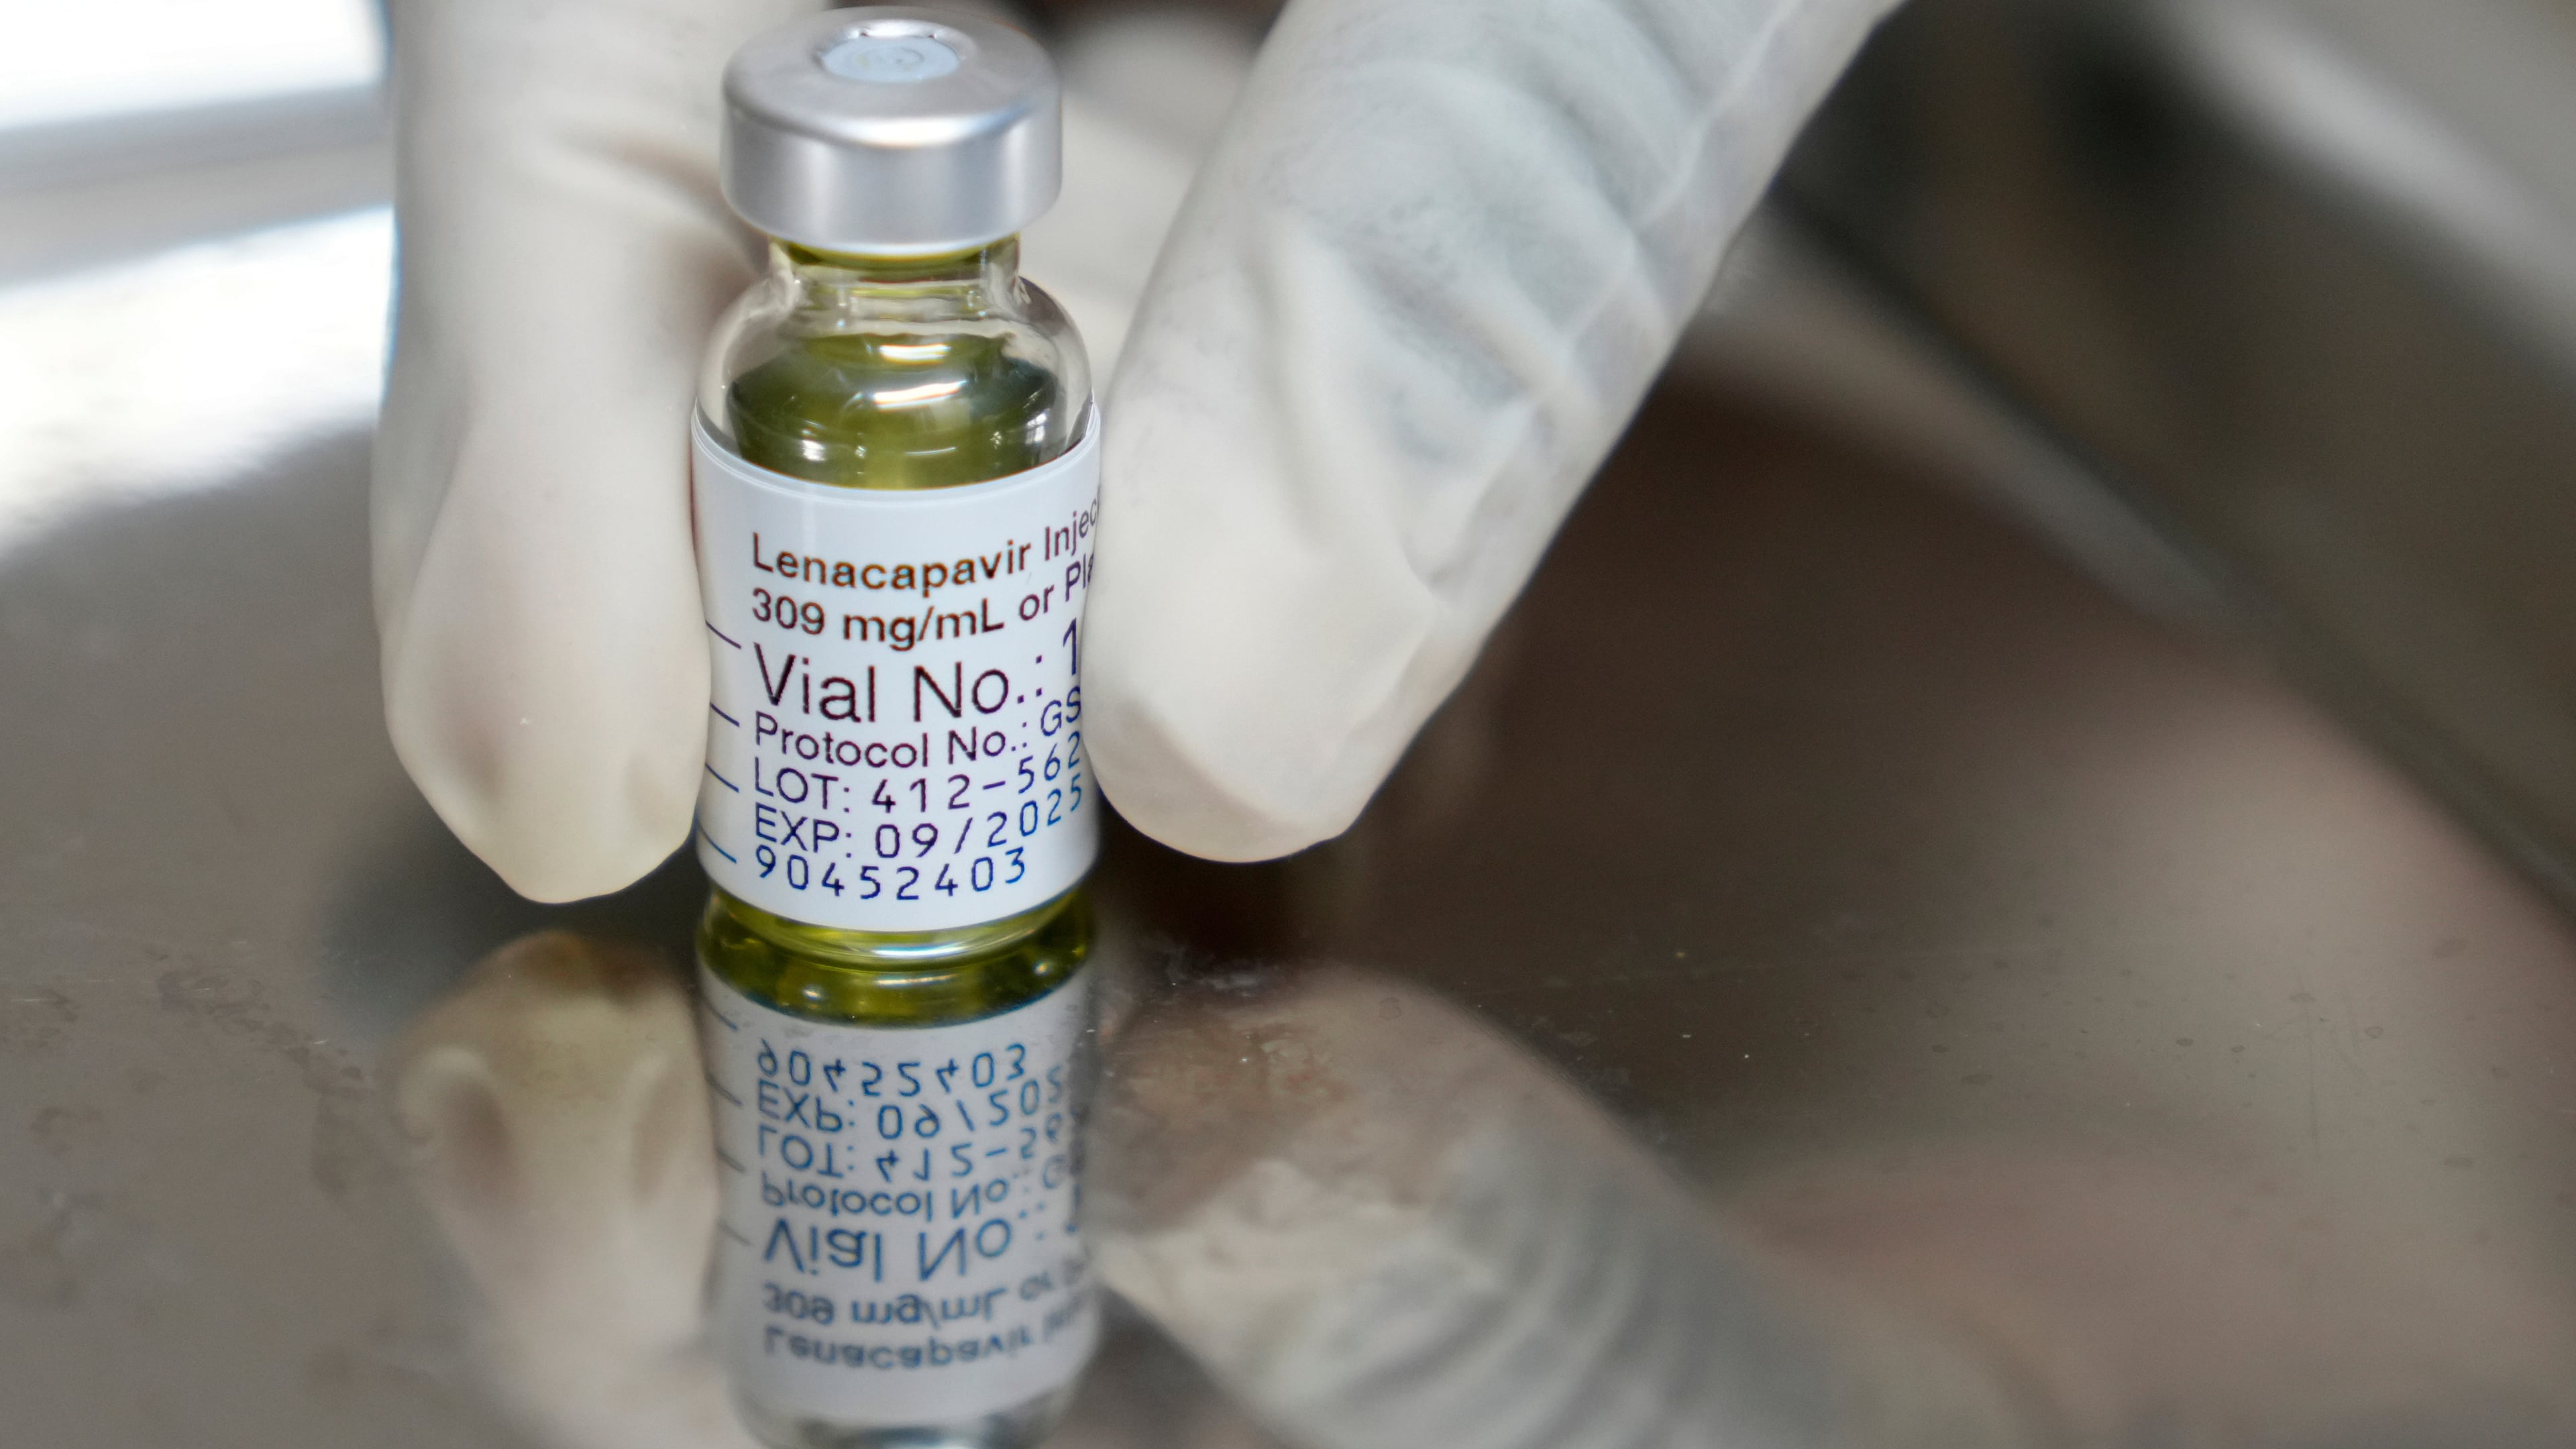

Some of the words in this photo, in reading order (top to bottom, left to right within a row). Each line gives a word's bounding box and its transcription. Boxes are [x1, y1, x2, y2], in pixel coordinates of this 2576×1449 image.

[753, 532, 1032, 599] Lenacapavir
[752, 587, 825, 636] 309
[843, 592, 1005, 652] mg/mL
[1018, 584, 1055, 622] or
[753, 642, 876, 723] Vial
[913, 655, 1043, 723] No.:
[755, 711, 928, 769] Protocol
[947, 721, 1028, 765] No.:
[1040, 686, 1081, 737] GS
[755, 757, 850, 813] LOT:
[871, 730, 1081, 814] 412-562
[755, 802, 852, 859] EXP:
[874, 773, 1082, 859] 09/2025
[755, 844, 1026, 901] 90452403
